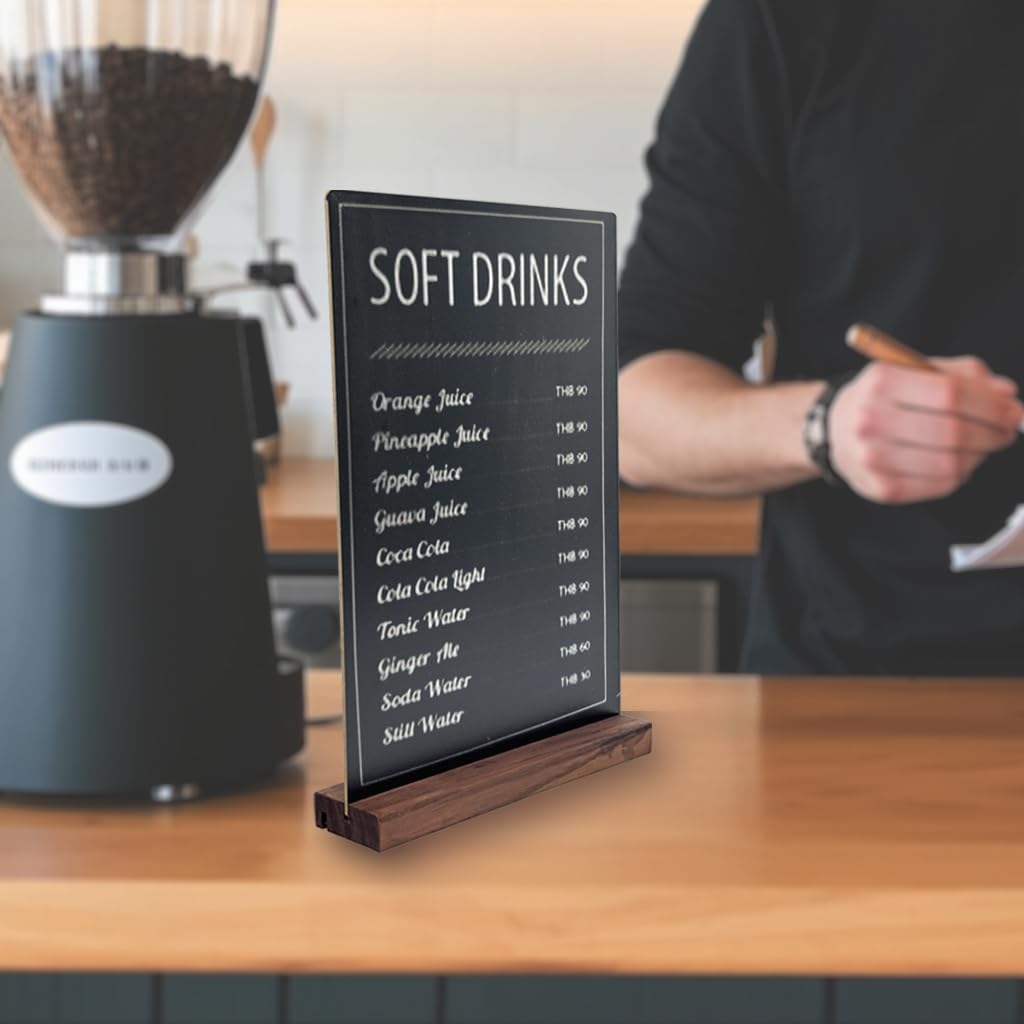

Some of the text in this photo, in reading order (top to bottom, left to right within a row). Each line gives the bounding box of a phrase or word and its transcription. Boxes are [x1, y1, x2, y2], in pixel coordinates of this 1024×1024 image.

[368, 246, 589, 307] SOFT DRINKS
[370, 391, 432, 415] Orange
[435, 387, 474, 413] Juice
[576, 384, 588, 397] 90
[372, 427, 450, 453] Pineapple
[453, 423, 491, 448] Juice
[576, 420, 588, 433] 90
[372, 469, 420, 494] Apple
[423, 463, 463, 489] Juice
[576, 451, 588, 464] 90
[374, 508, 426, 534] Guava
[429, 498, 468, 525] Juice
[577, 484, 589, 497] 90
[376, 547, 413, 567] Coca
[416, 539, 450, 559] Cola
[577, 516, 589, 529] 90
[377, 582, 412, 605] Cola
[415, 575, 449, 596] Cola
[451, 566, 486, 593] Light
[578, 548, 590, 561] 90
[377, 616, 420, 641] Tonic
[423, 607, 471, 630] Water
[578, 580, 590, 593] 90
[378, 652, 431, 682] Ginger
[436, 641, 460, 664] Ale
[579, 609, 591, 623] 90
[381, 687, 422, 712] Soda
[424, 675, 473, 698] Water
[579, 640, 591, 653] 60
[382, 721, 415, 746] Still
[417, 710, 465, 734] Water
